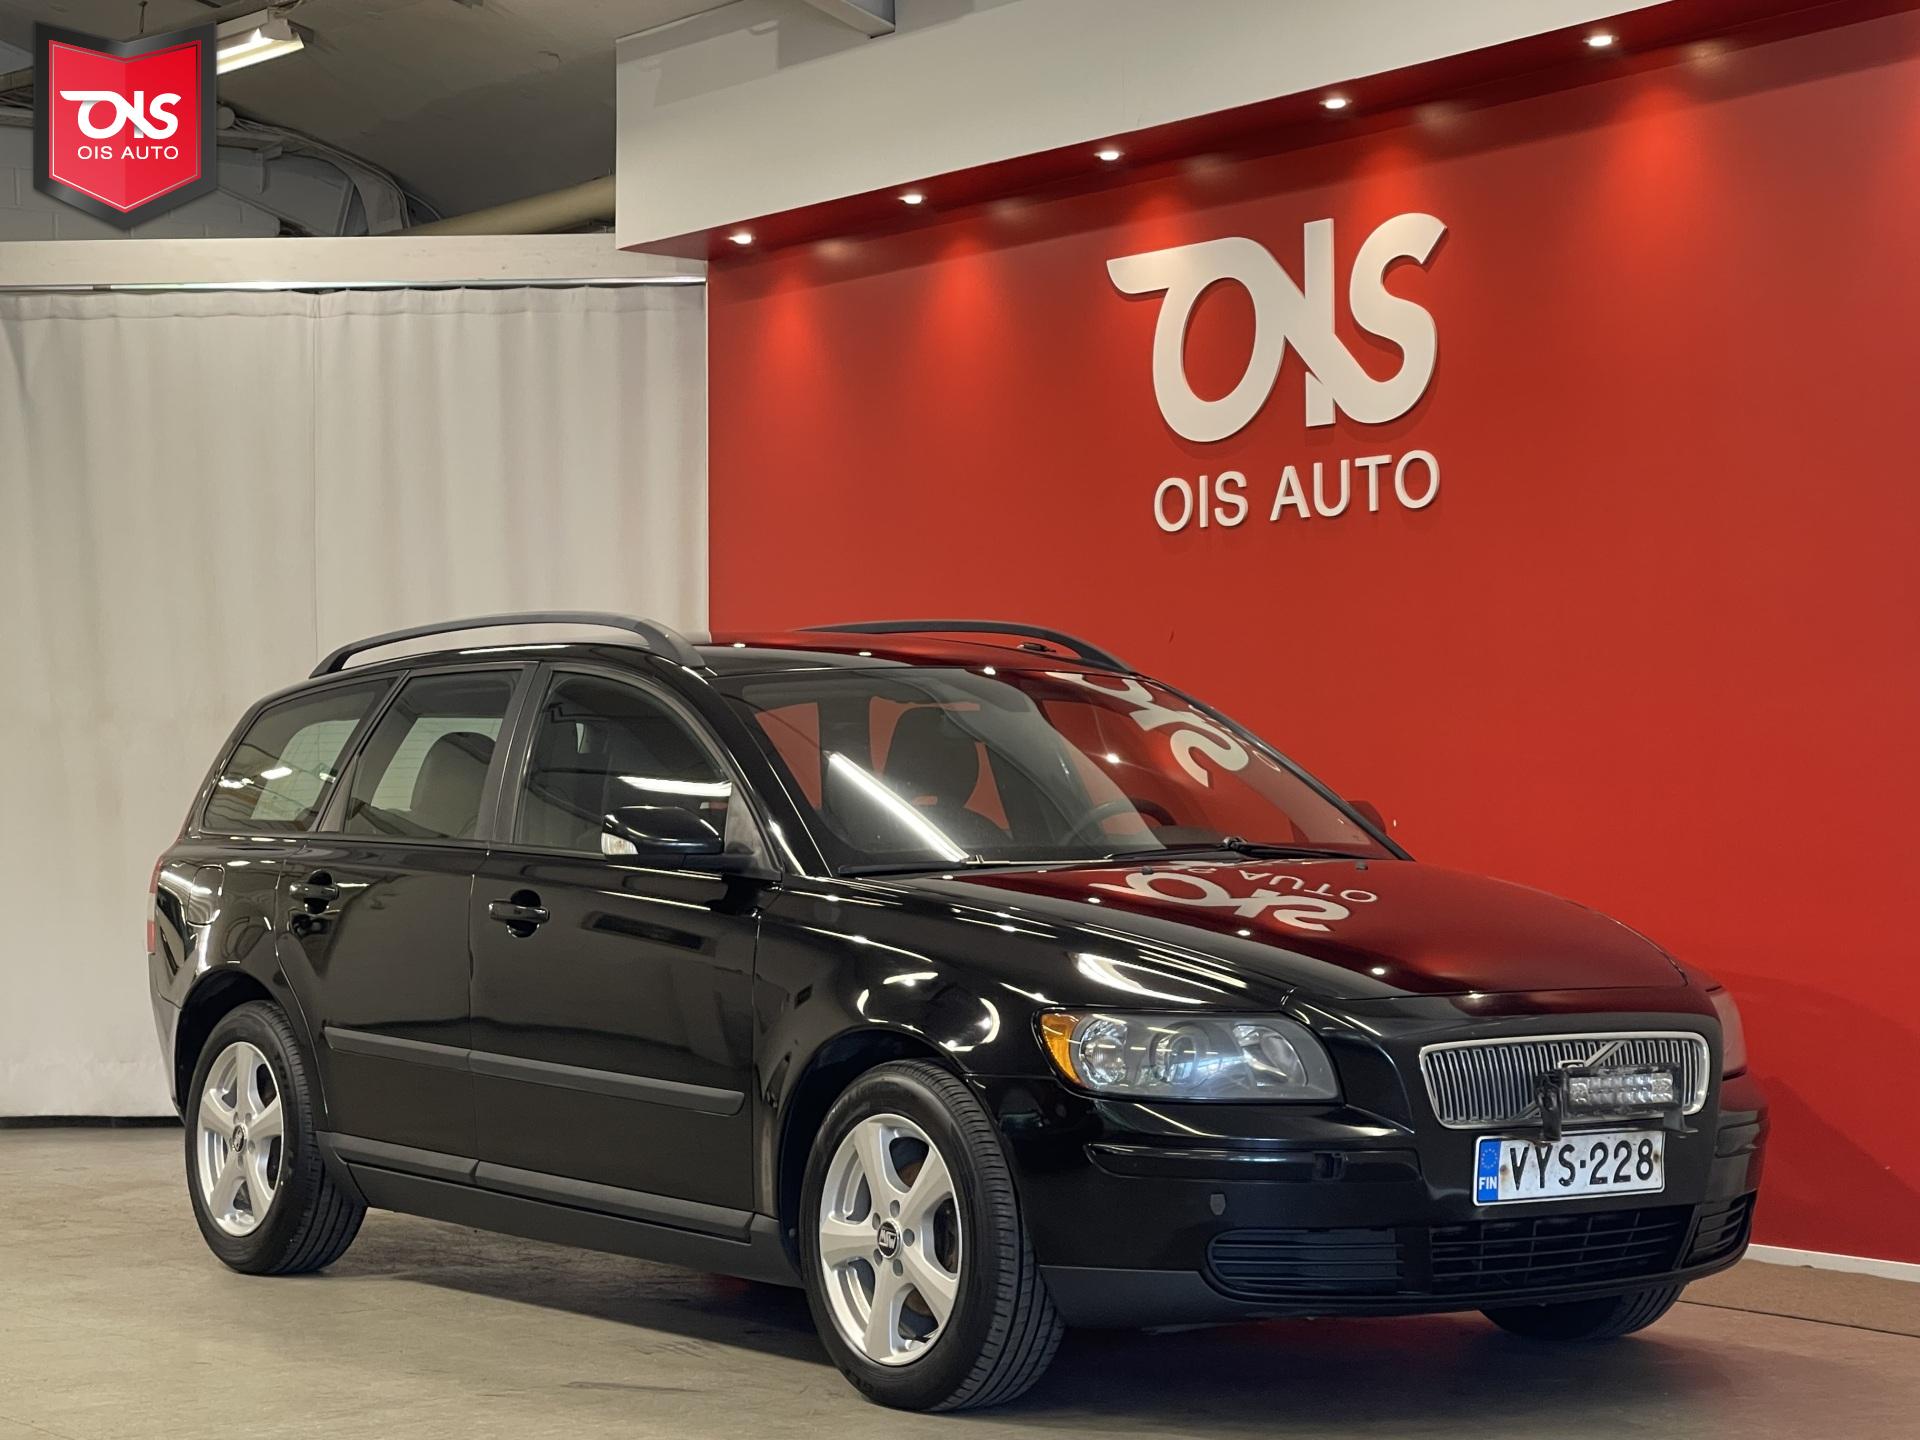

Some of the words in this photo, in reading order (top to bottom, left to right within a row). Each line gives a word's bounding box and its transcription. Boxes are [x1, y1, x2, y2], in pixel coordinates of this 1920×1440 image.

[1153, 471, 1248, 532] OIS
[1269, 449, 1441, 521] AUTO
[1478, 1176, 1498, 1190] FIN
[1509, 1138, 1653, 1191] VYS-228
